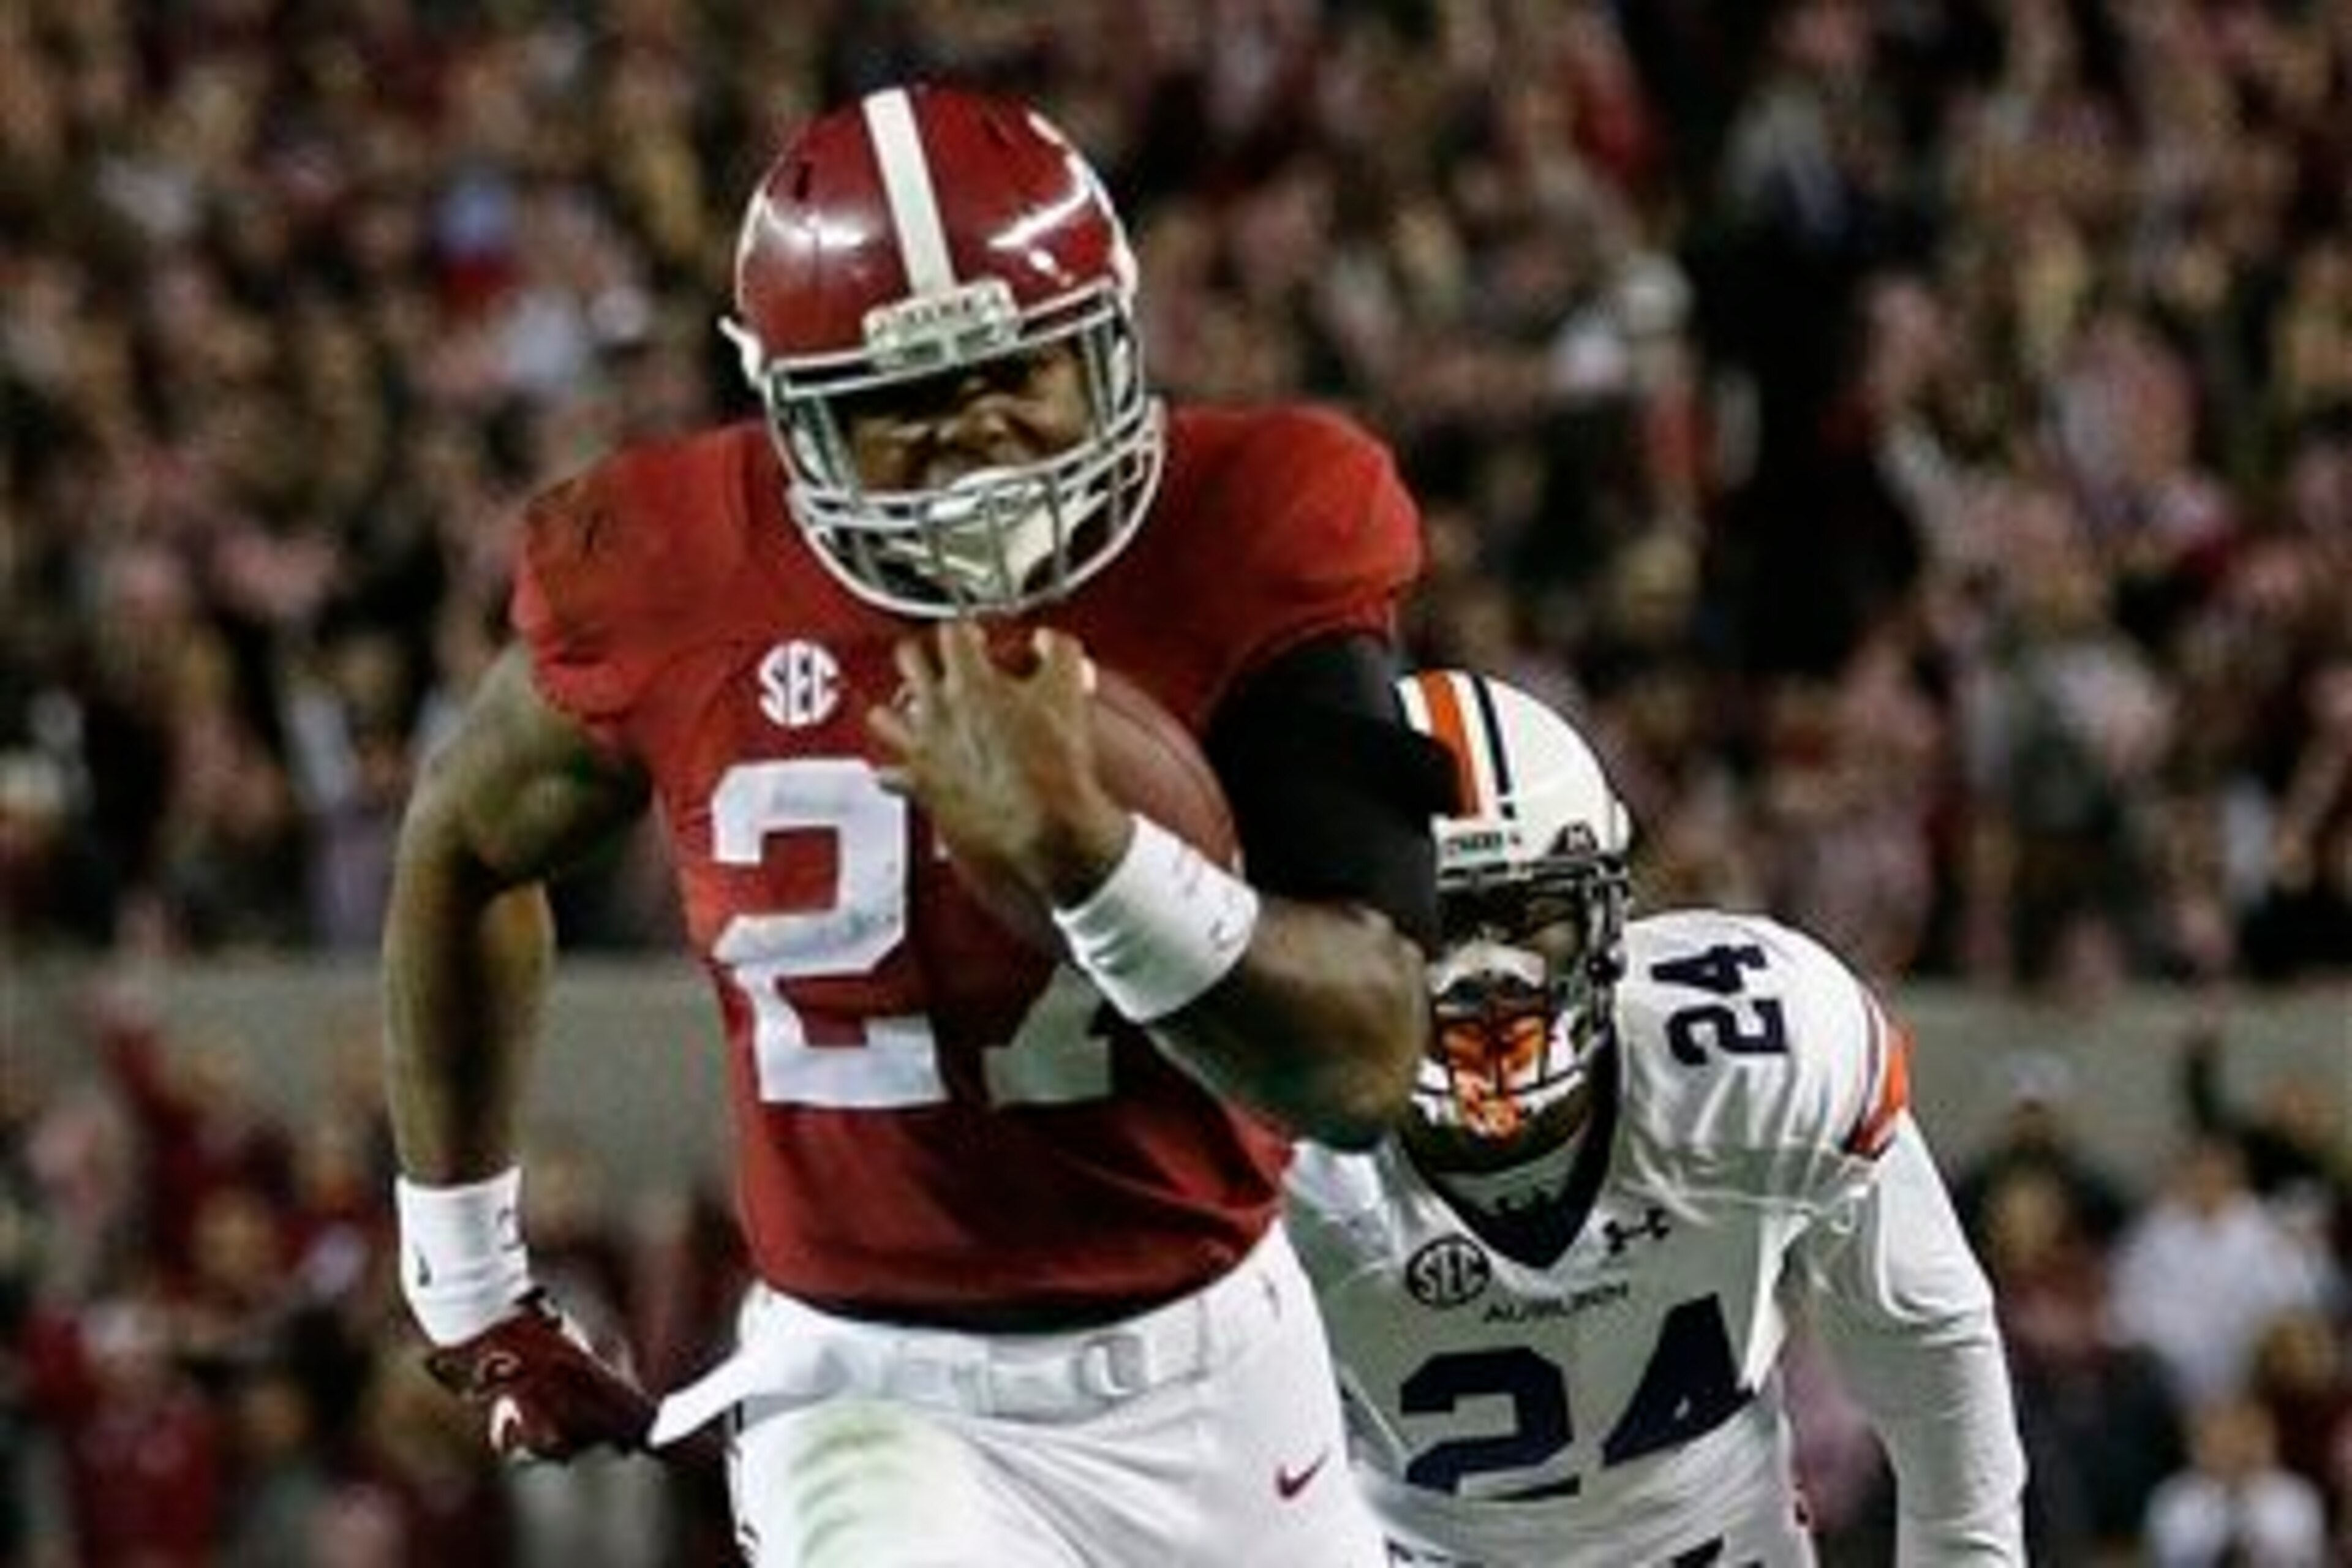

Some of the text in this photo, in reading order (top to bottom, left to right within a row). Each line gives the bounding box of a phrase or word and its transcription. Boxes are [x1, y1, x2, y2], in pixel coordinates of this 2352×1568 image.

[758, 639, 839, 726] SEC
[1650, 944, 1789, 1066] 24
[1409, 1236, 1490, 1308] SEC
[1401, 1292, 1757, 1501] 24
